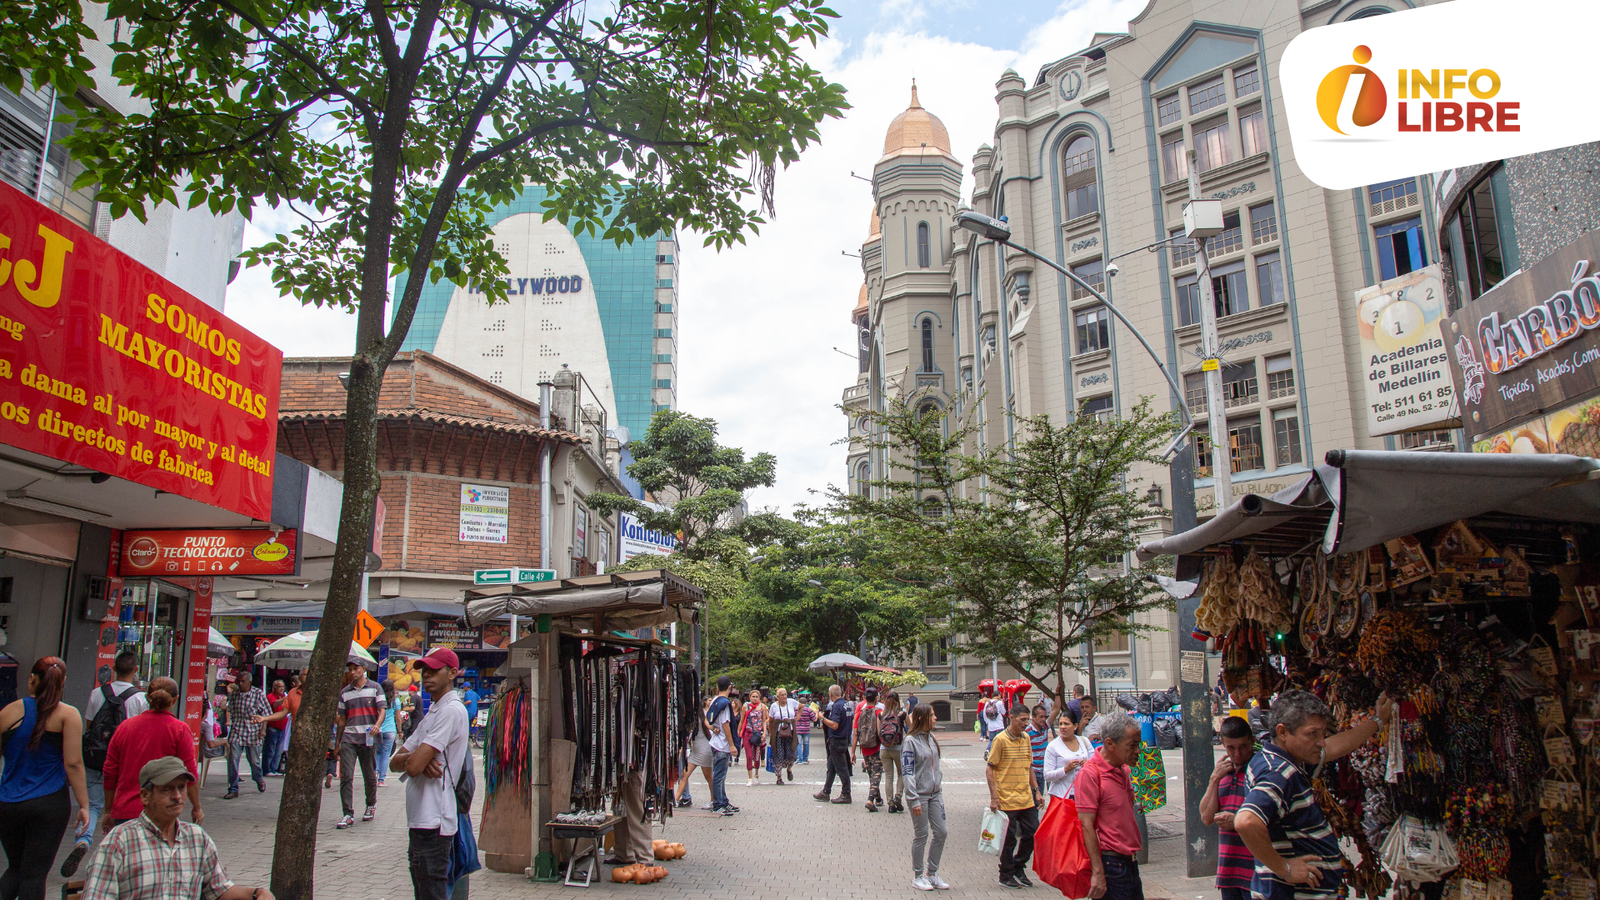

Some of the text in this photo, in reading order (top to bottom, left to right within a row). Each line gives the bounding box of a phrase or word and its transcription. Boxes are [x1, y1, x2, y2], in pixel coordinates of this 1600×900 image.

[1425, 287, 1435, 301] 2
[1394, 321, 1404, 335] 1
[1477, 260, 1600, 374] CARBÓ
[146, 293, 241, 365] SOMOS
[1370, 338, 1443, 366] Academia
[98, 313, 267, 420] MAYORISTAS
[1369, 353, 1447, 381] de Billares
[1378, 370, 1441, 393] Medellín
[1498, 378, 1535, 401] Típicos,
[1371, 386, 1452, 413] Tel: 511 61 85
[1376, 413, 1395, 422] Calle
[1408, 407, 1421, 415] No.
[1422, 403, 1433, 411] 52
[1438, 400, 1449, 408] 26
[20, 363, 88, 406] dama
[93, 393, 113, 416] al
[116, 404, 150, 430] por
[154, 419, 205, 450] mayor
[207, 441, 218, 459] y
[221, 445, 235, 463] al
[238, 449, 270, 477] detal
[37, 408, 126, 456] directos
[130, 441, 153, 465] de
[157, 449, 214, 486] fabrica
[1248, 483, 1285, 495] PALACIO
[183, 536, 226, 548] PUNTO
[621, 516, 676, 547] Konicolor
[131, 547, 156, 556] Claro
[163, 544, 245, 558] TECNOLÓGICO
[255, 547, 286, 556] Colombia
[520, 572, 545, 581] Calle 49
[429, 629, 479, 638] ENVIGADEÑAS
